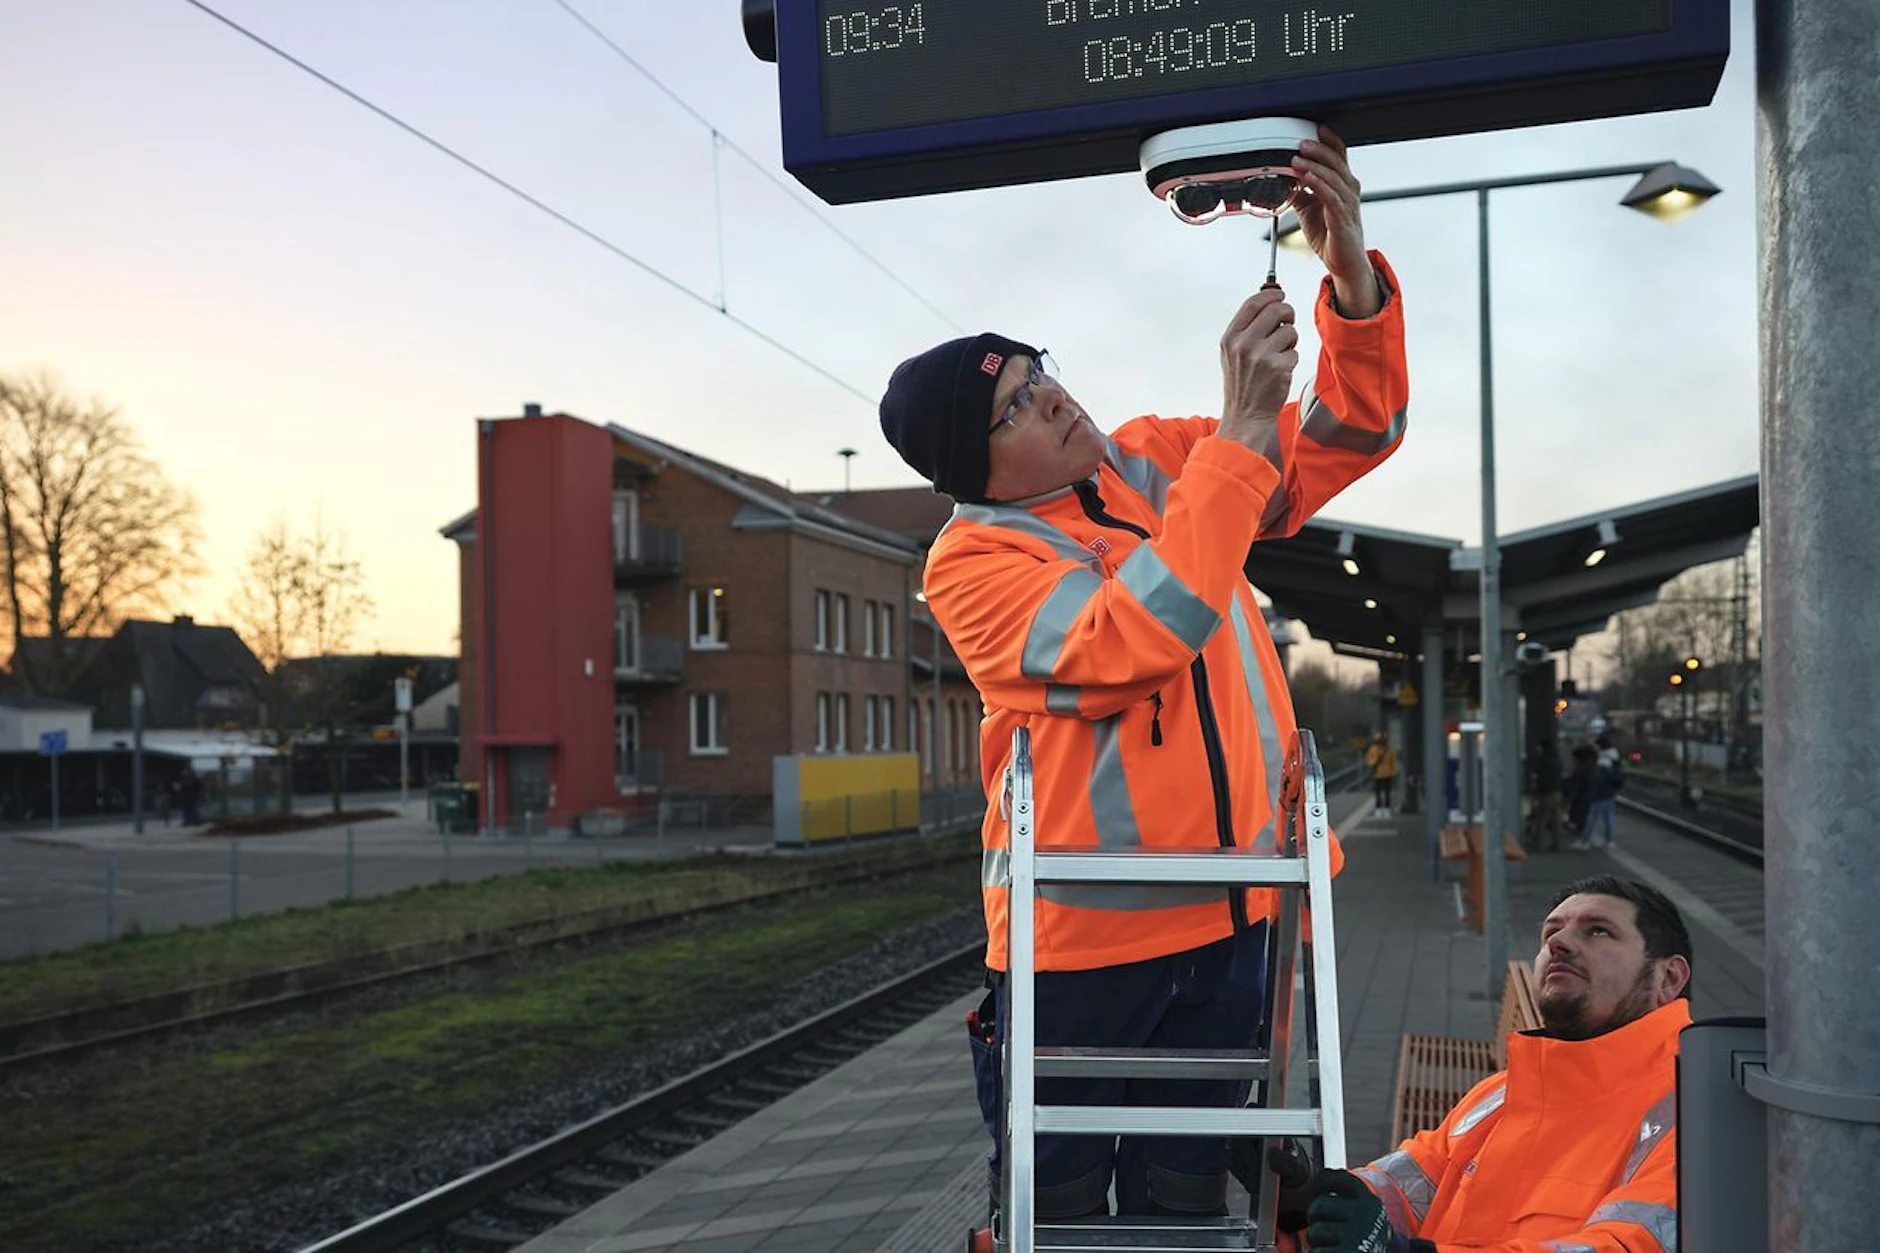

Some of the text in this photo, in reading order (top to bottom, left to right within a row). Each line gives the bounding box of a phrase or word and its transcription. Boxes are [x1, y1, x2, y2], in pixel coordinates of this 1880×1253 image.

[825, 3, 925, 56] 09:34
[1047, 0, 1199, 26] Bre
[1084, 9, 1355, 83] 08:49:09 Uhr
[982, 353, 1001, 375] DB
